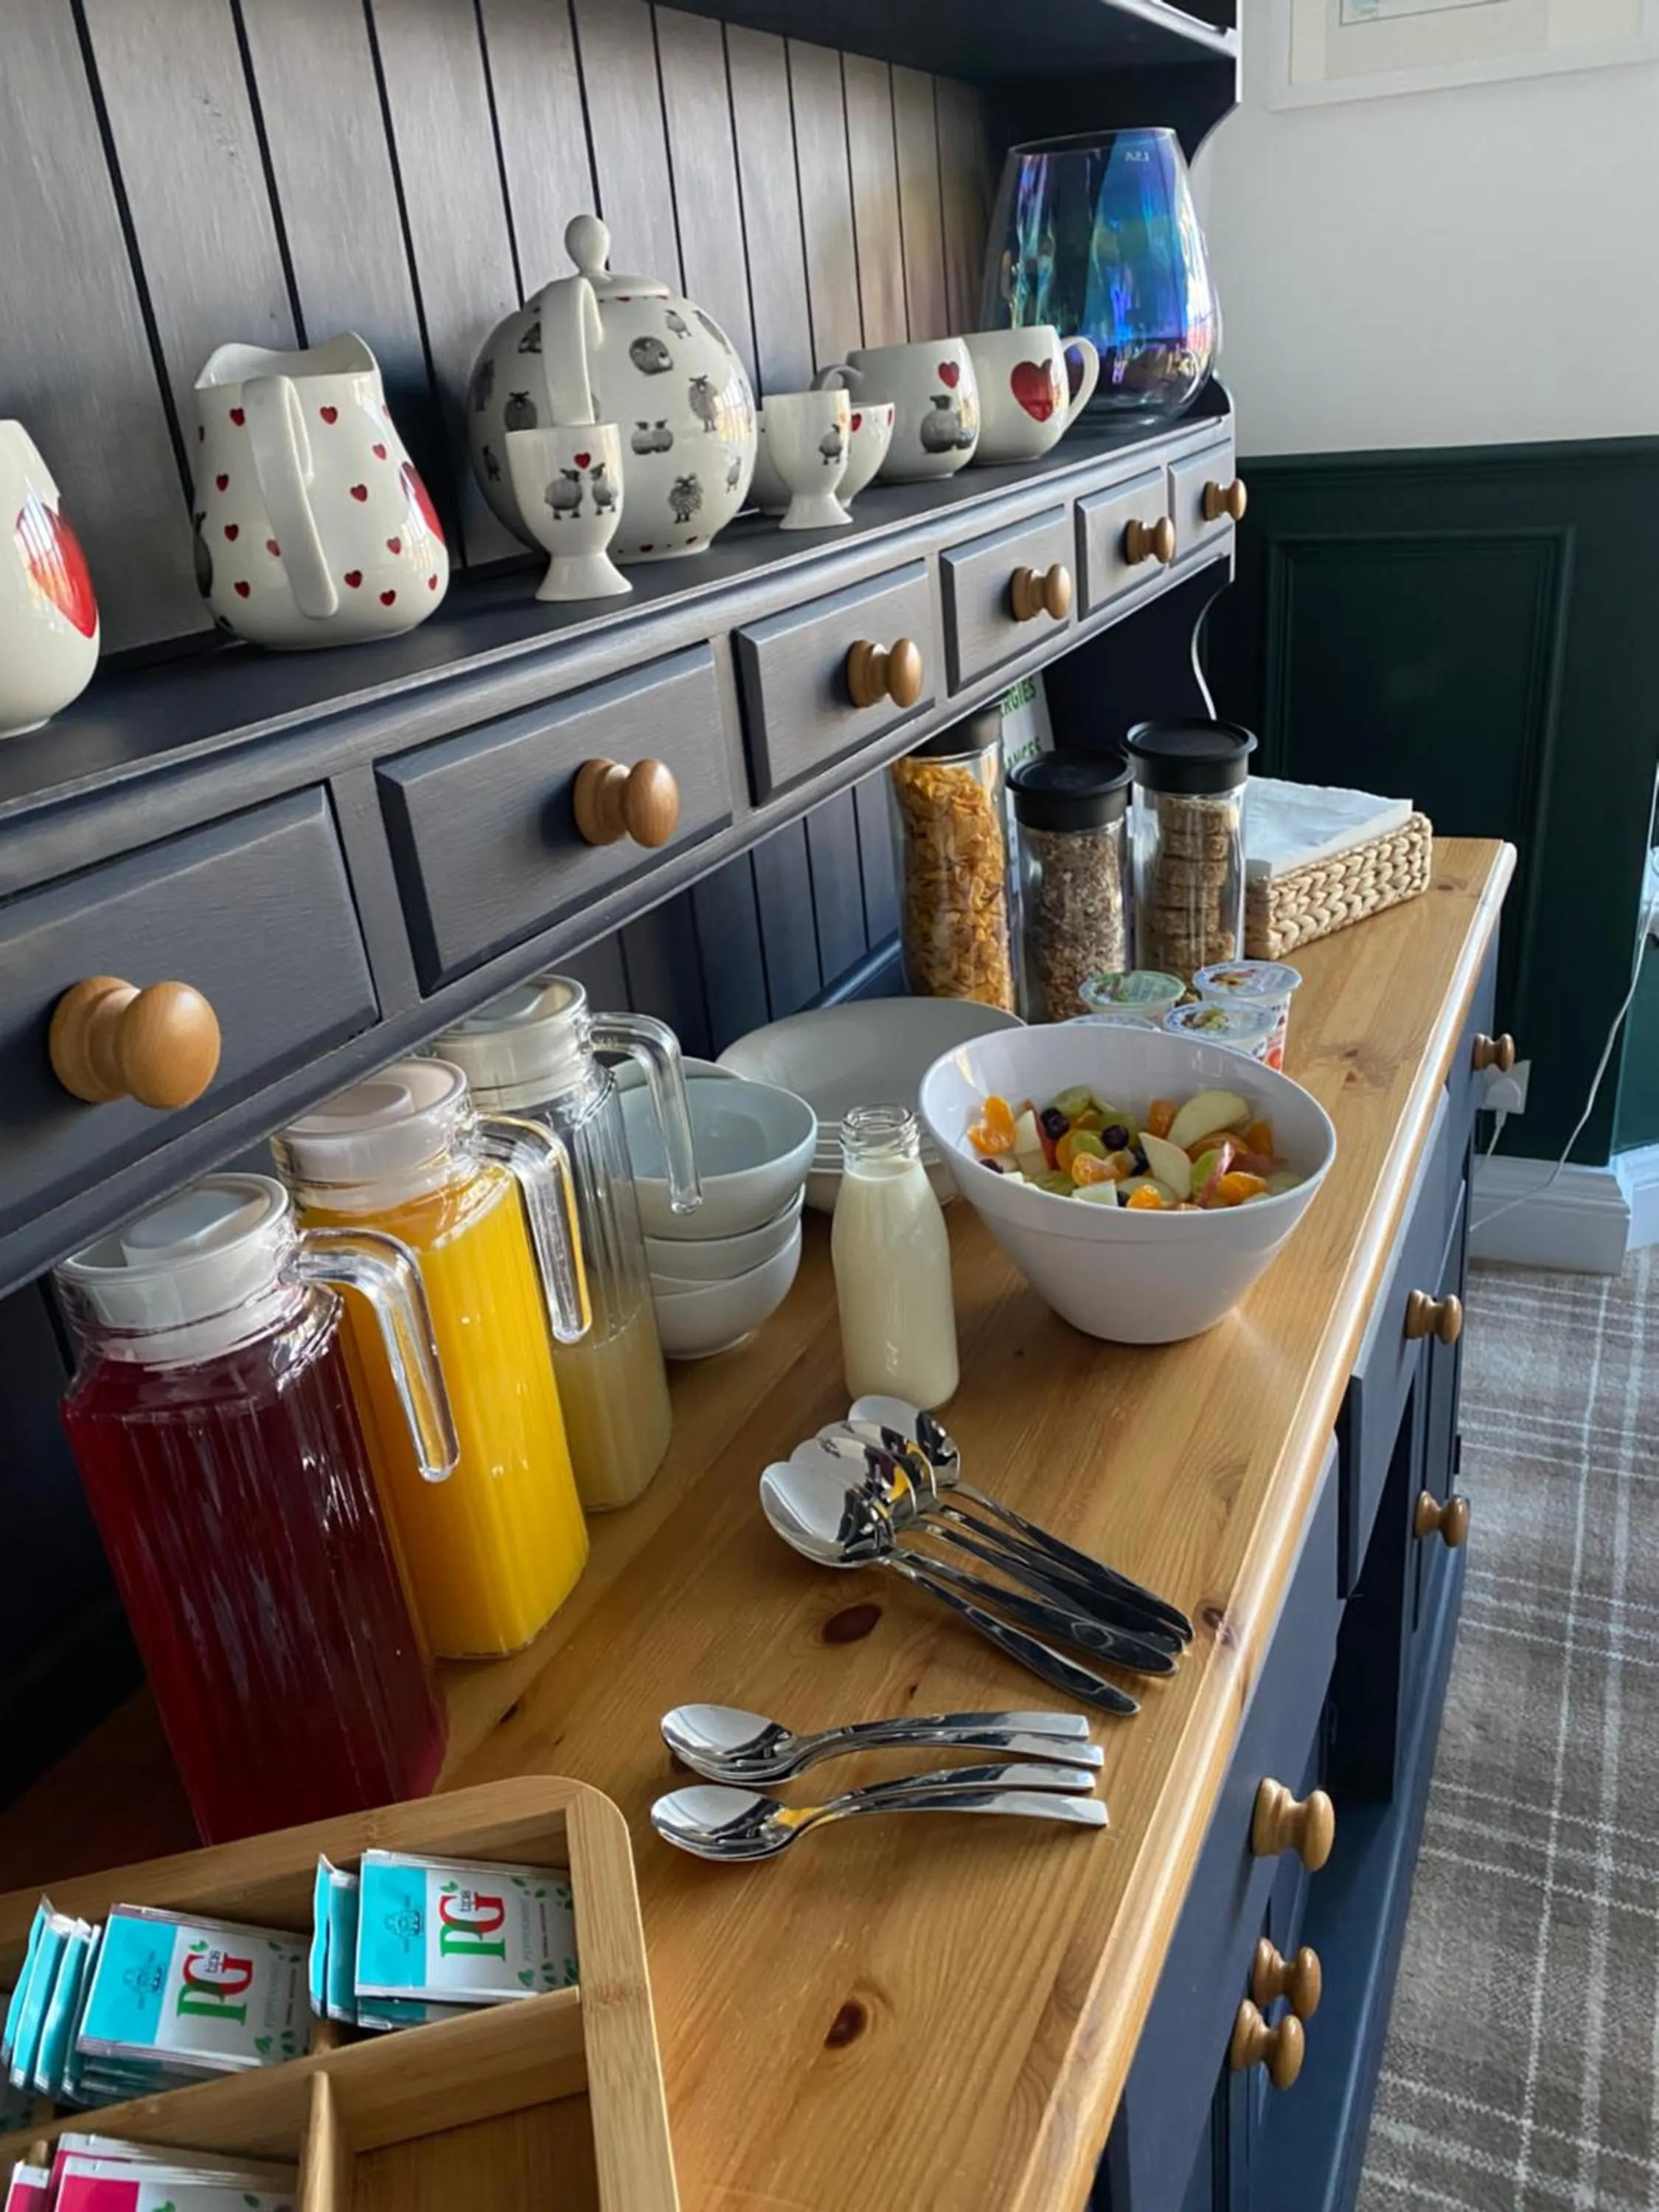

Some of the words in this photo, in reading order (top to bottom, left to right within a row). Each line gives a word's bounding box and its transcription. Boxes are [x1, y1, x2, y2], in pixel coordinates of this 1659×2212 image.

[204, 1950, 222, 1973] tips
[439, 1891, 506, 1962] PG
[176, 1952, 253, 2026] PG
